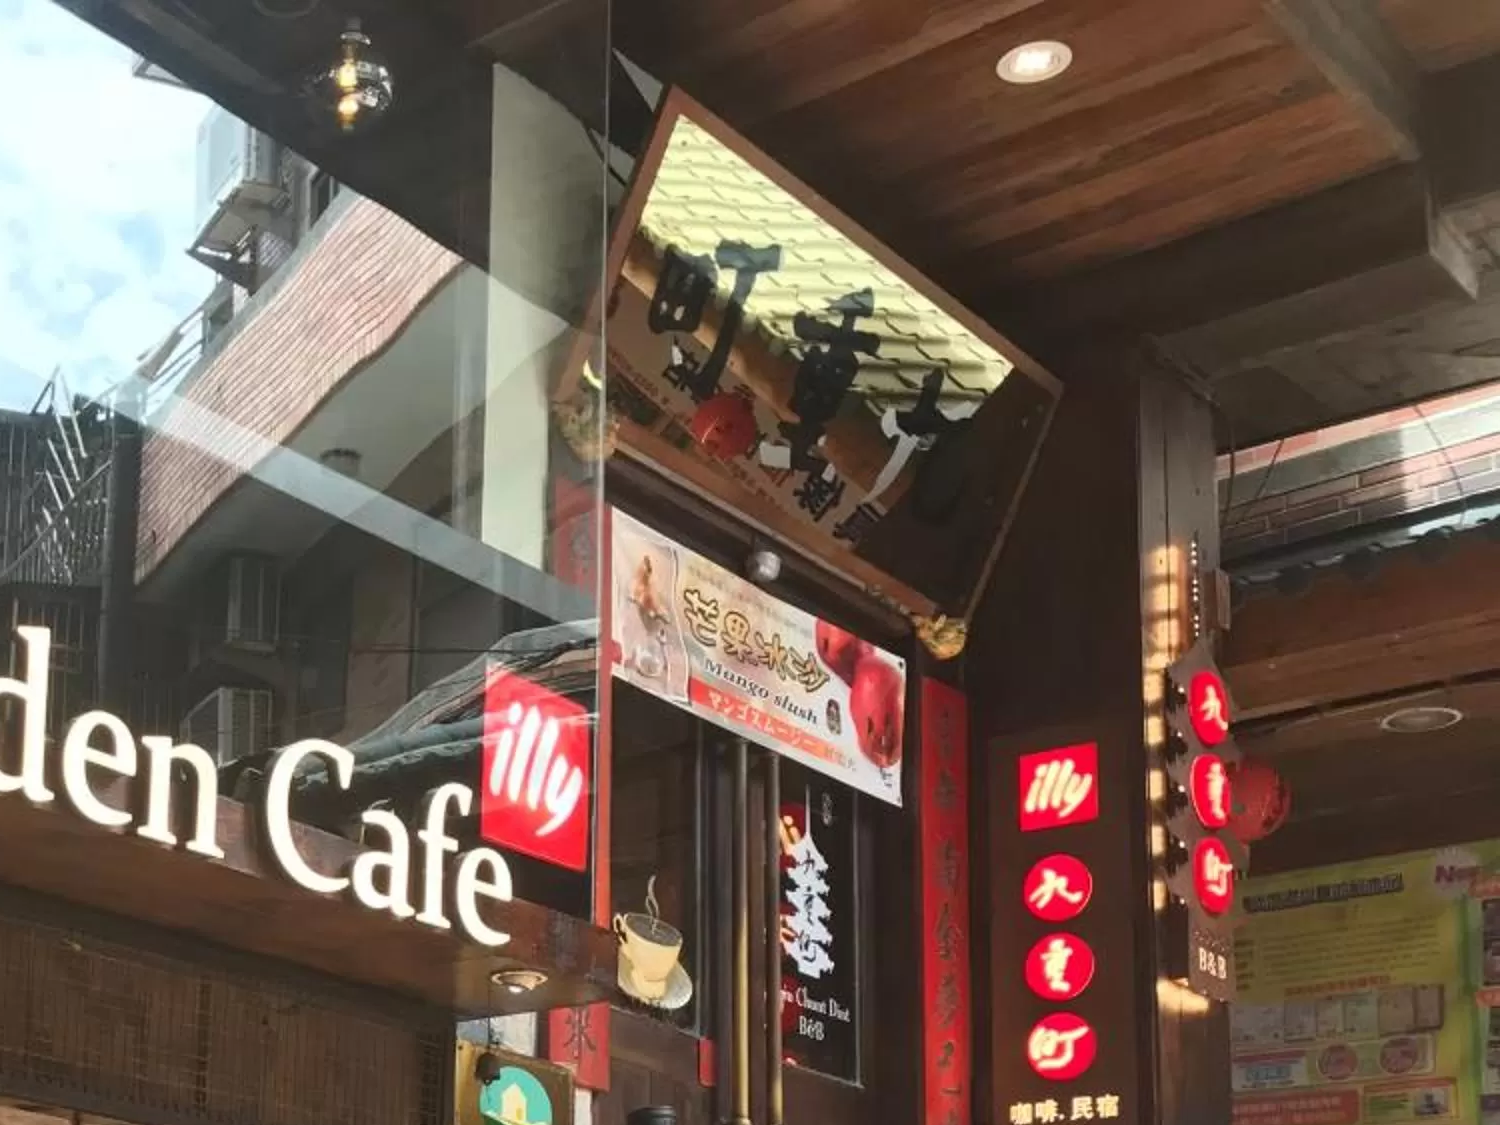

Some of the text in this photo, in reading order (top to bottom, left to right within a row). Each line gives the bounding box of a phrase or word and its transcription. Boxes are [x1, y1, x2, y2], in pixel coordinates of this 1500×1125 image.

[684, 588, 830, 693] 芒果冰沙
[704, 659, 770, 700] Mango
[774, 691, 819, 725] slush
[490, 701, 583, 837] illy
[1025, 757, 1093, 818] illy
[268, 737, 513, 947] Cafe
[1198, 946, 1228, 980] B&B
